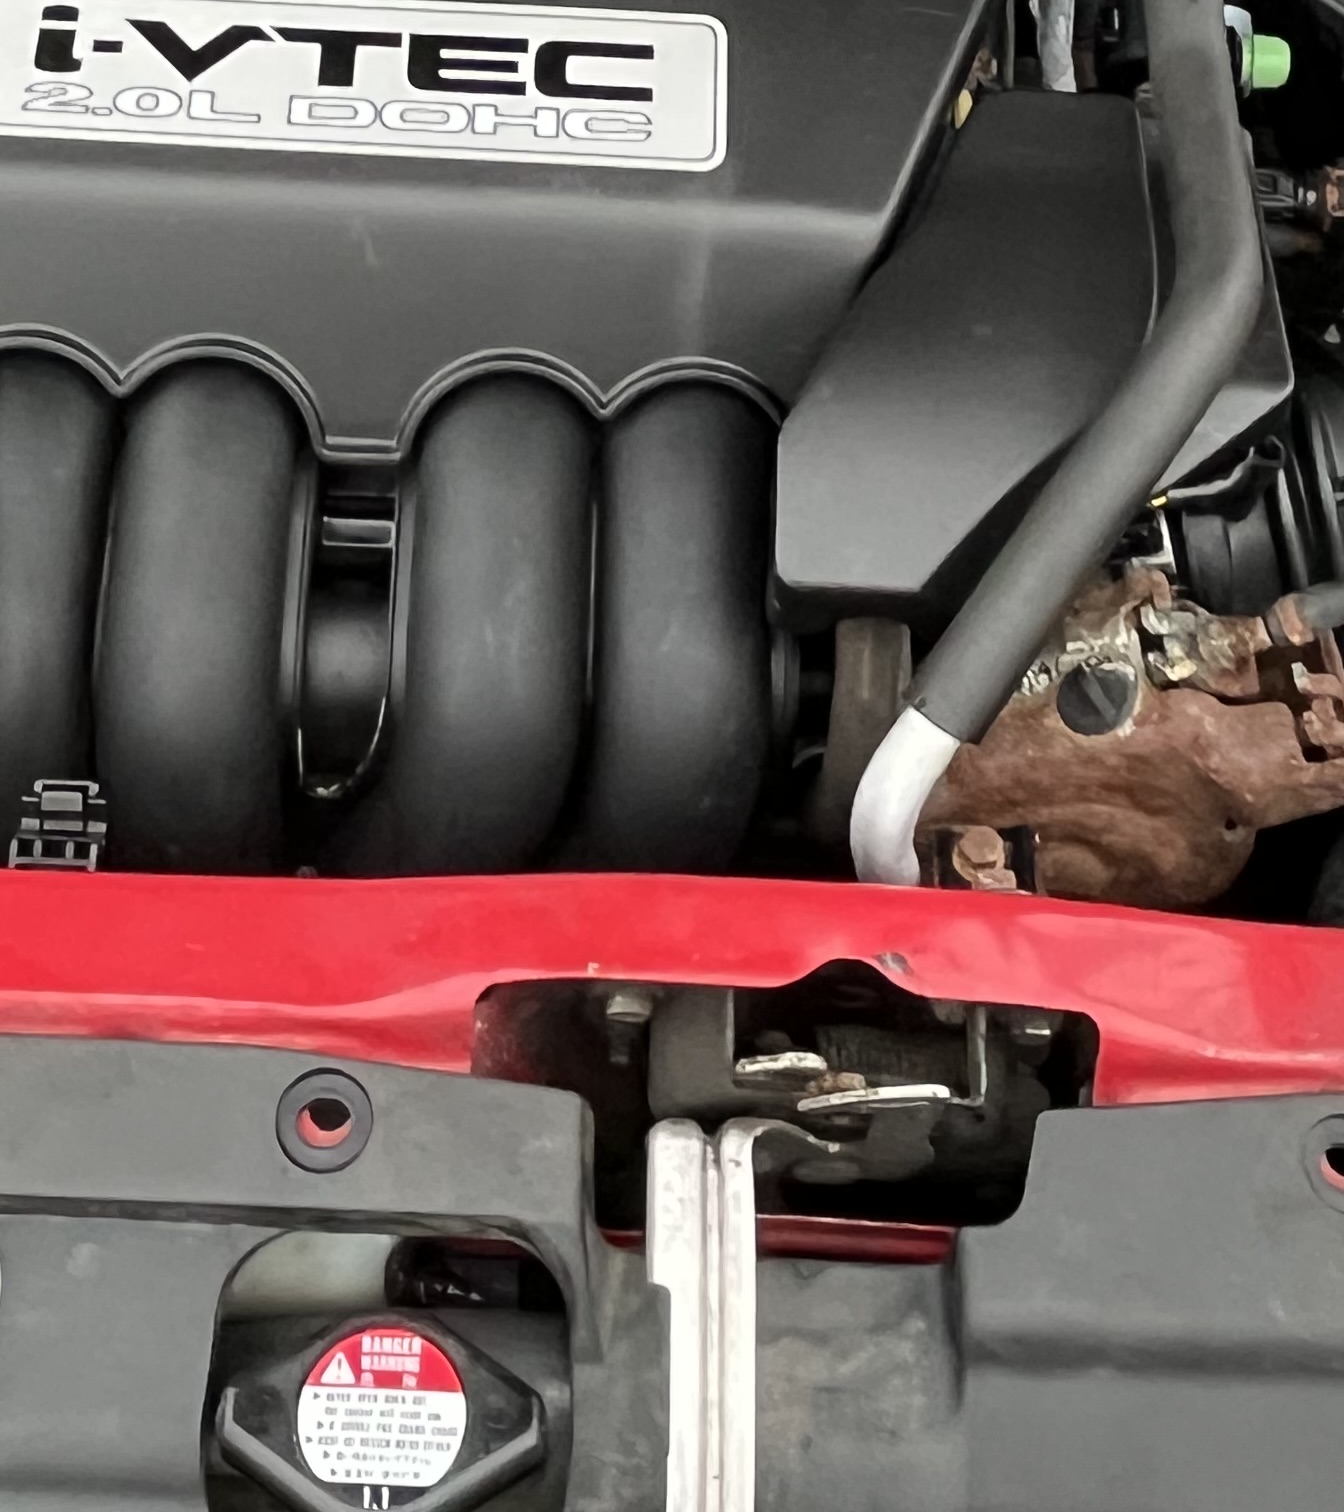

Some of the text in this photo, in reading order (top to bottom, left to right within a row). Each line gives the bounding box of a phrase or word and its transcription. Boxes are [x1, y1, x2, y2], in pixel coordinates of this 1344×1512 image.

[33, 5, 654, 102] i-VTEC
[22, 81, 652, 142] 2.0L DOHC
